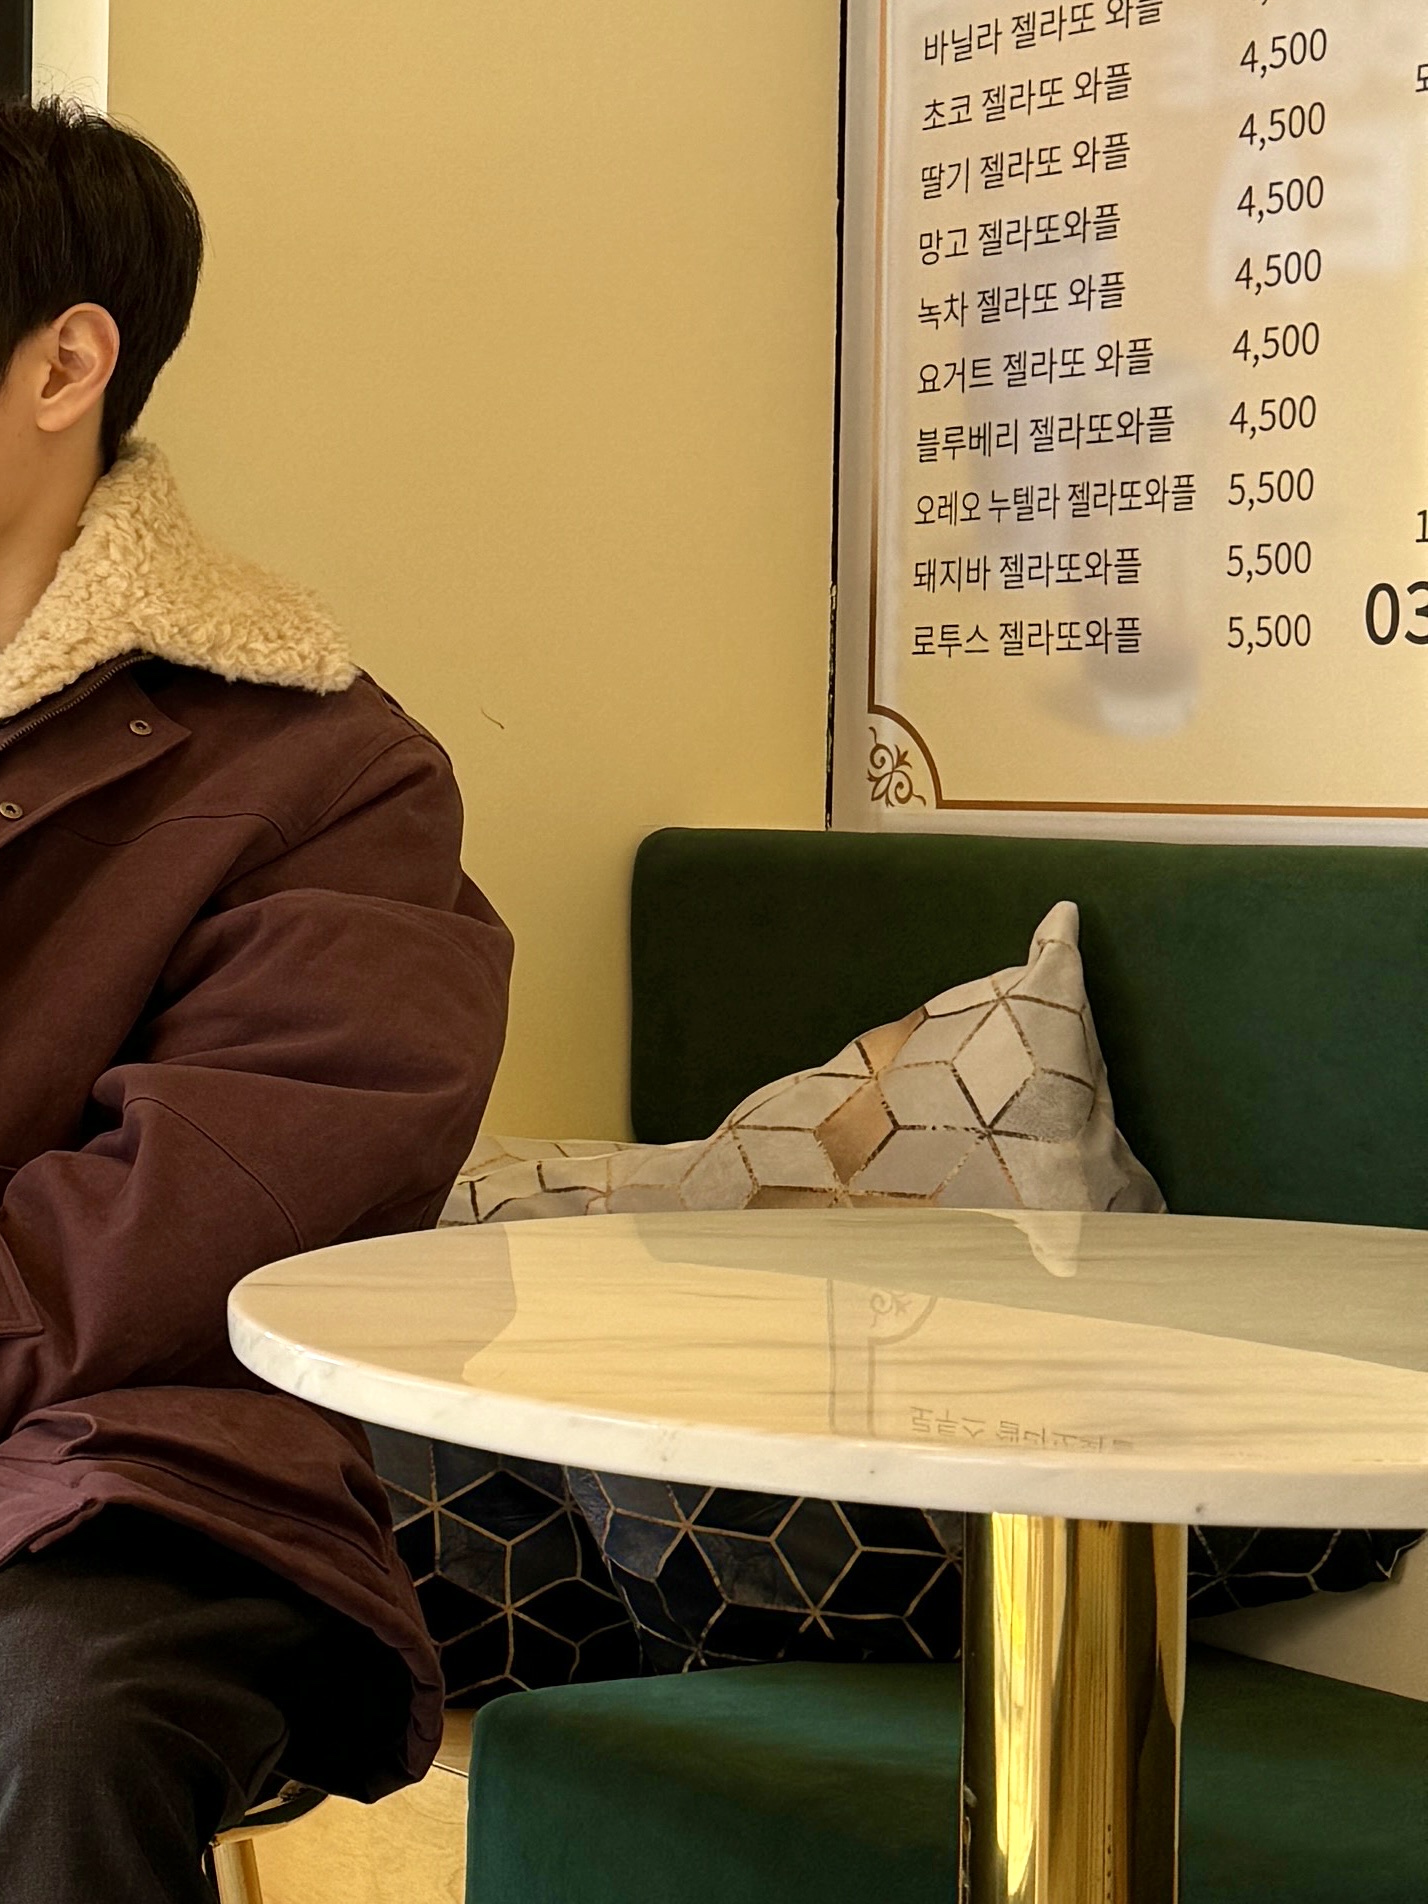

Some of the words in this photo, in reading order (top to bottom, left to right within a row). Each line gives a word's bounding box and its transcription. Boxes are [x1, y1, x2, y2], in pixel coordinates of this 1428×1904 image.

[924, 17, 1003, 66] 바닐라
[1010, 1, 1097, 50] 젤라또
[1240, 28, 1328, 79] 4,500
[921, 94, 973, 132] 초코
[981, 76, 1065, 123] 젤라또
[1073, 62, 1133, 105] 와플
[1238, 101, 1326, 151] 4,500
[920, 156, 970, 200] 딸기
[979, 145, 1063, 190] 젤라또
[1072, 132, 1131, 174] 와플
[1237, 174, 1325, 224] 4,500
[919, 227, 970, 266] 망고
[977, 202, 1121, 257] 젤라또와플
[1235, 248, 1322, 297] 4,500
[917, 290, 969, 331] 녹차
[976, 281, 1060, 325] 젤라또
[1067, 271, 1127, 313] 와플
[917, 356, 994, 394] 요거트
[1002, 346, 1087, 388] 젤라또
[1094, 337, 1155, 378] 와플
[1232, 322, 1320, 368] 4,500
[916, 417, 1019, 464] 블루베리
[1029, 404, 1175, 454] 젤라또와플
[1229, 394, 1317, 440] 4,500
[914, 489, 982, 526] 오레오
[987, 482, 1061, 524] 누텔라
[1067, 473, 1197, 519] 젤라또와플
[1227, 468, 1315, 512] 5,500
[912, 554, 991, 594] 돼지바
[999, 547, 1143, 591] 젤라또와플
[1226, 540, 1312, 584] 5,500
[911, 622, 990, 659] 로투스
[999, 616, 1143, 657] 젤라또와플
[1226, 613, 1312, 656] 5,500
